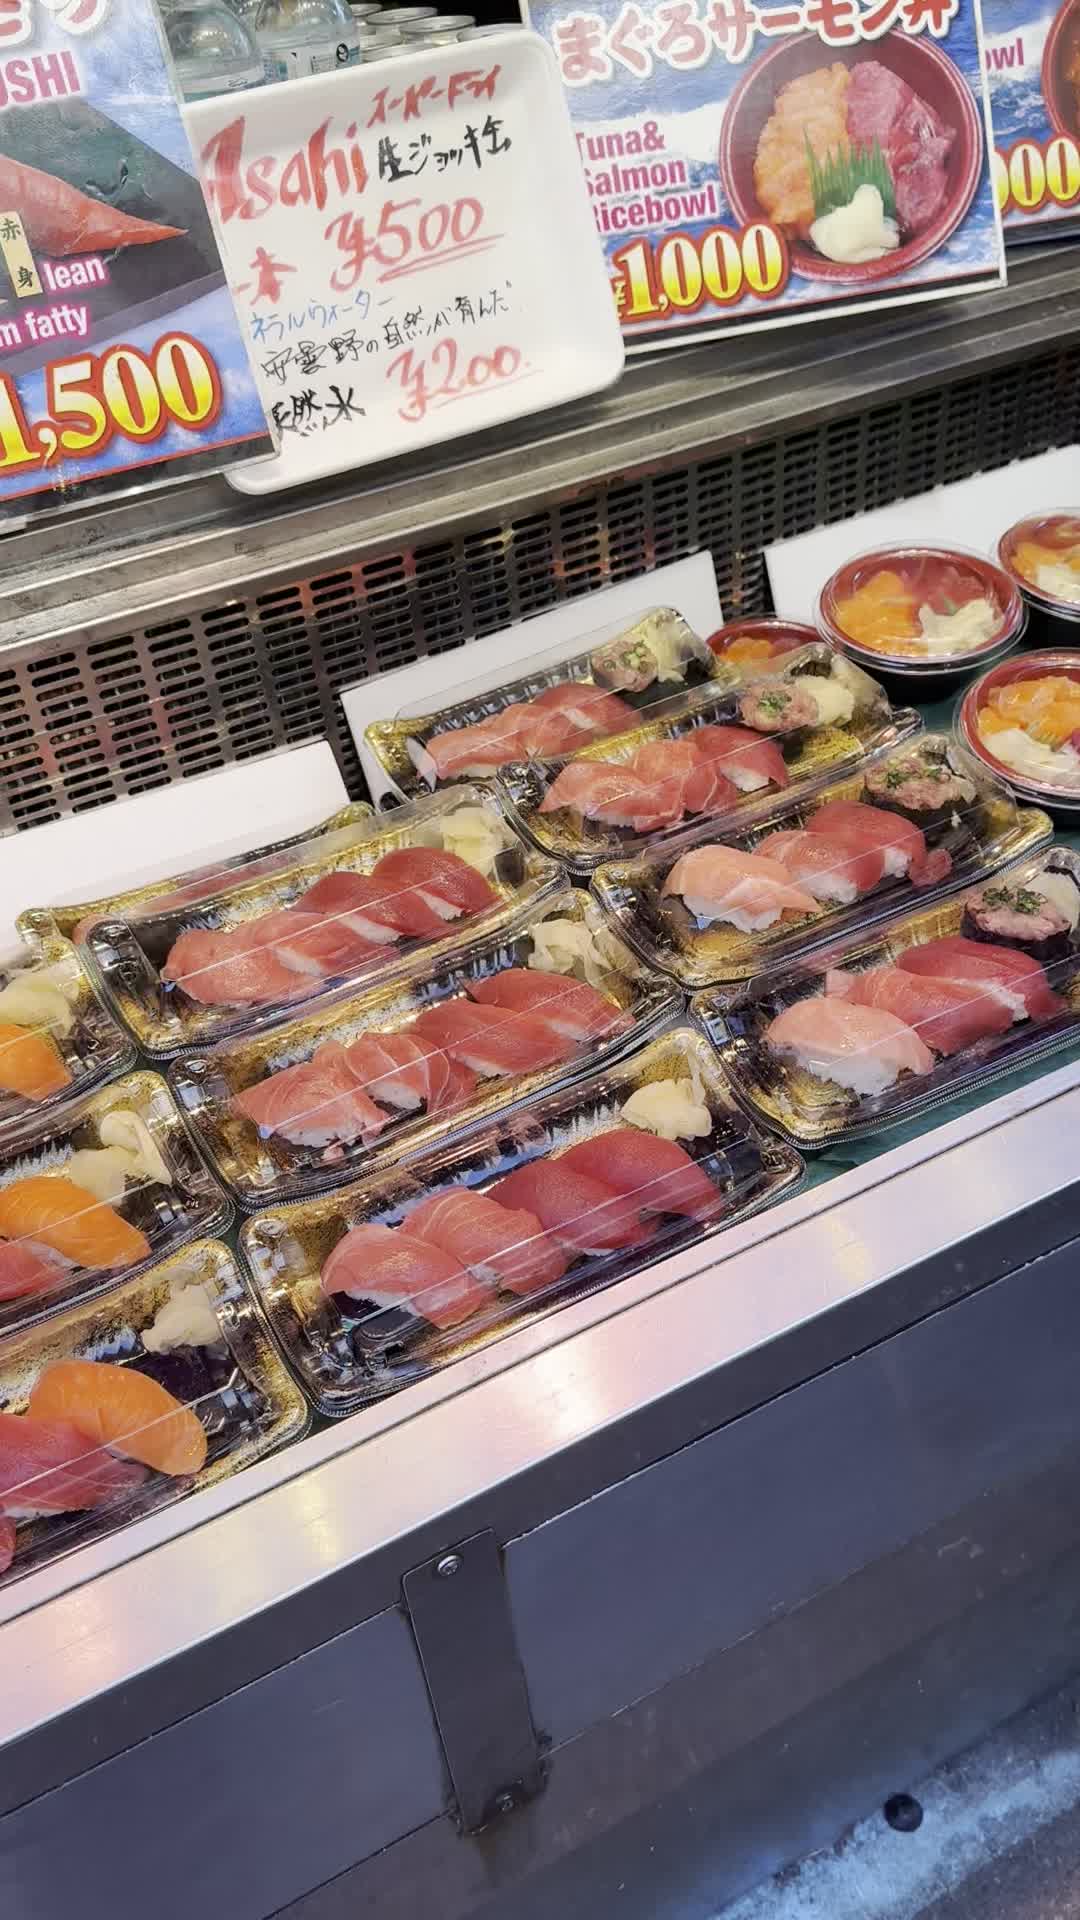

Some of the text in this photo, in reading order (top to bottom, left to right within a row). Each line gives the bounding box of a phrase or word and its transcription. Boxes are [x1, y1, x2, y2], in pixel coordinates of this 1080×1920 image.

[200, 114, 369, 224] Asahi
[593, 185, 716, 233] icebowl
[0, 218, 36, 289] 赤身
[43, 257, 105, 291] lean
[323, 197, 485, 293] ¥500
[24, 304, 88, 341] fatty
